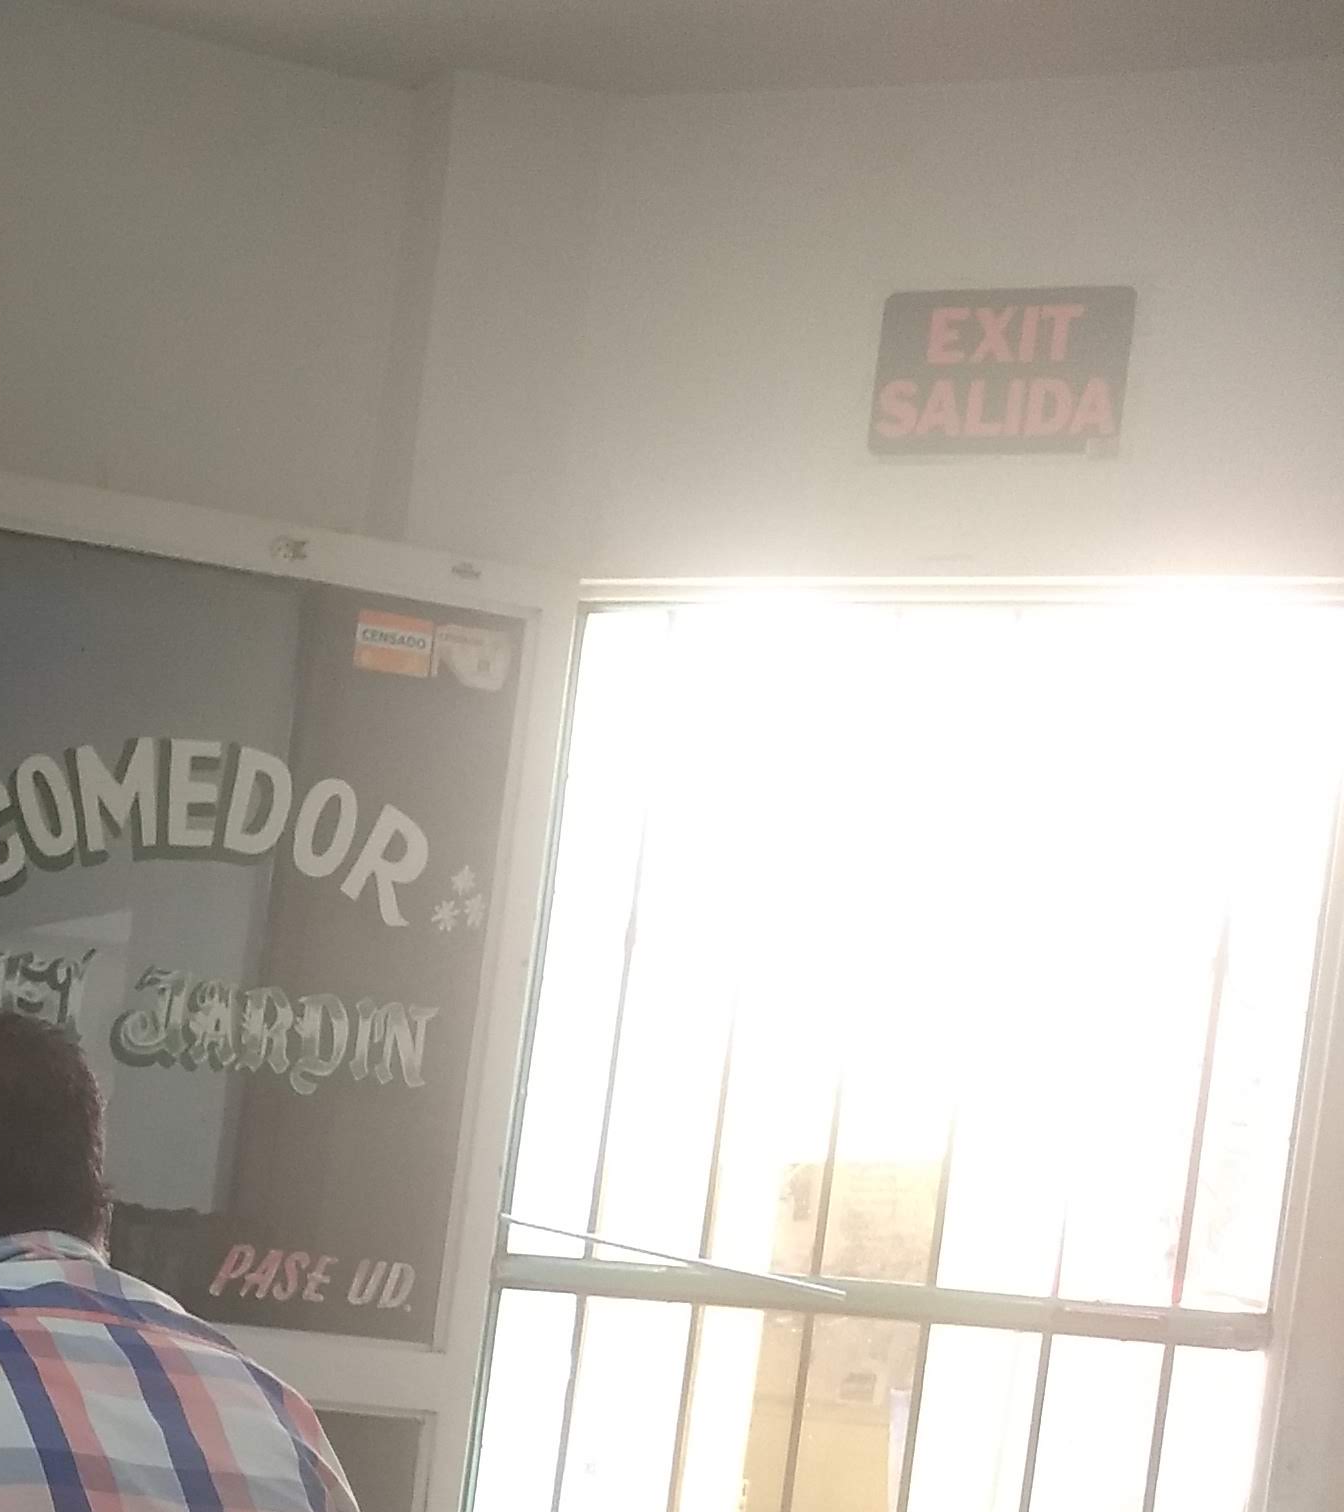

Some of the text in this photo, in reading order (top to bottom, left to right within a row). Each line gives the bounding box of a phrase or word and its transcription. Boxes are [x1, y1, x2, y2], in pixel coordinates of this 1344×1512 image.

[927, 303, 1088, 364] EXIT
[877, 376, 1117, 437] SALIDA
[362, 628, 426, 650] CENSADO
[209, 1244, 415, 1312] PASE UD.
